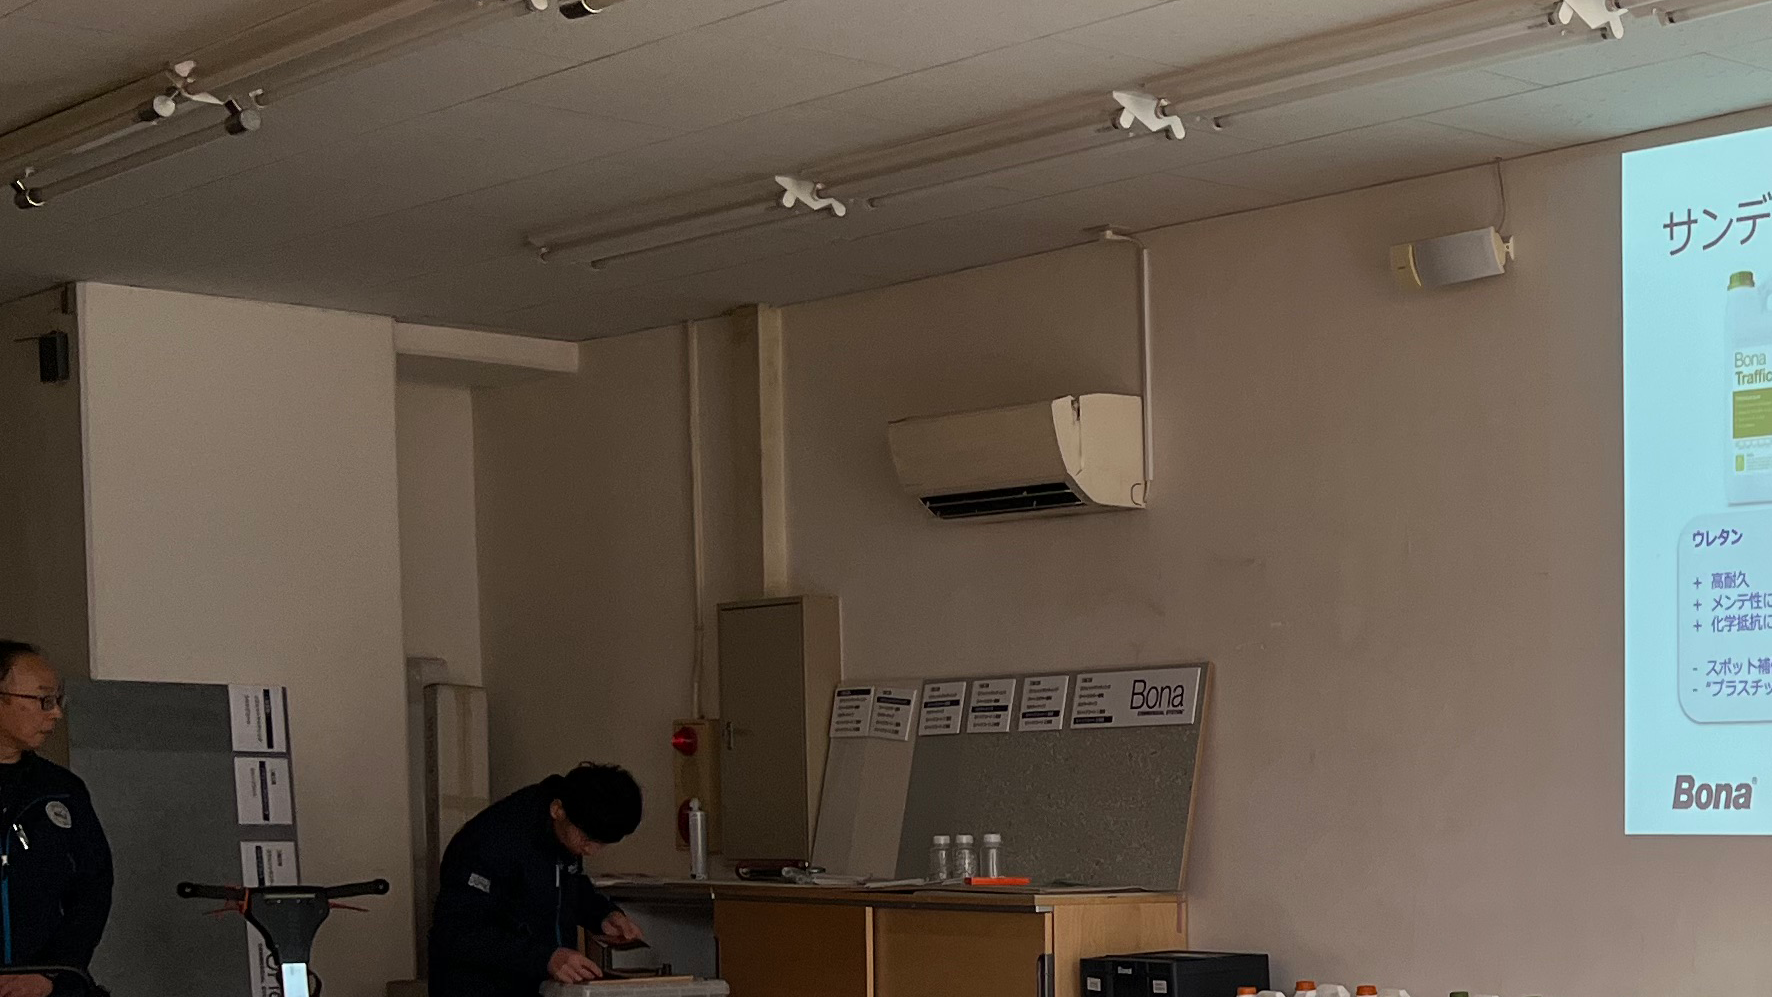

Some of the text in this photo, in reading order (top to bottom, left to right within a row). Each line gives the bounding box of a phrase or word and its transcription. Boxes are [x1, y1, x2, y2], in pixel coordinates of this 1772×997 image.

[1734, 352, 1767, 368] Bona
[1735, 368, 1772, 385] Traffic
[1692, 528, 1743, 548] ウレタン
[1711, 570, 1750, 590] 高耐久
[1130, 679, 1185, 710] Bona
[1672, 774, 1753, 810] Bona
